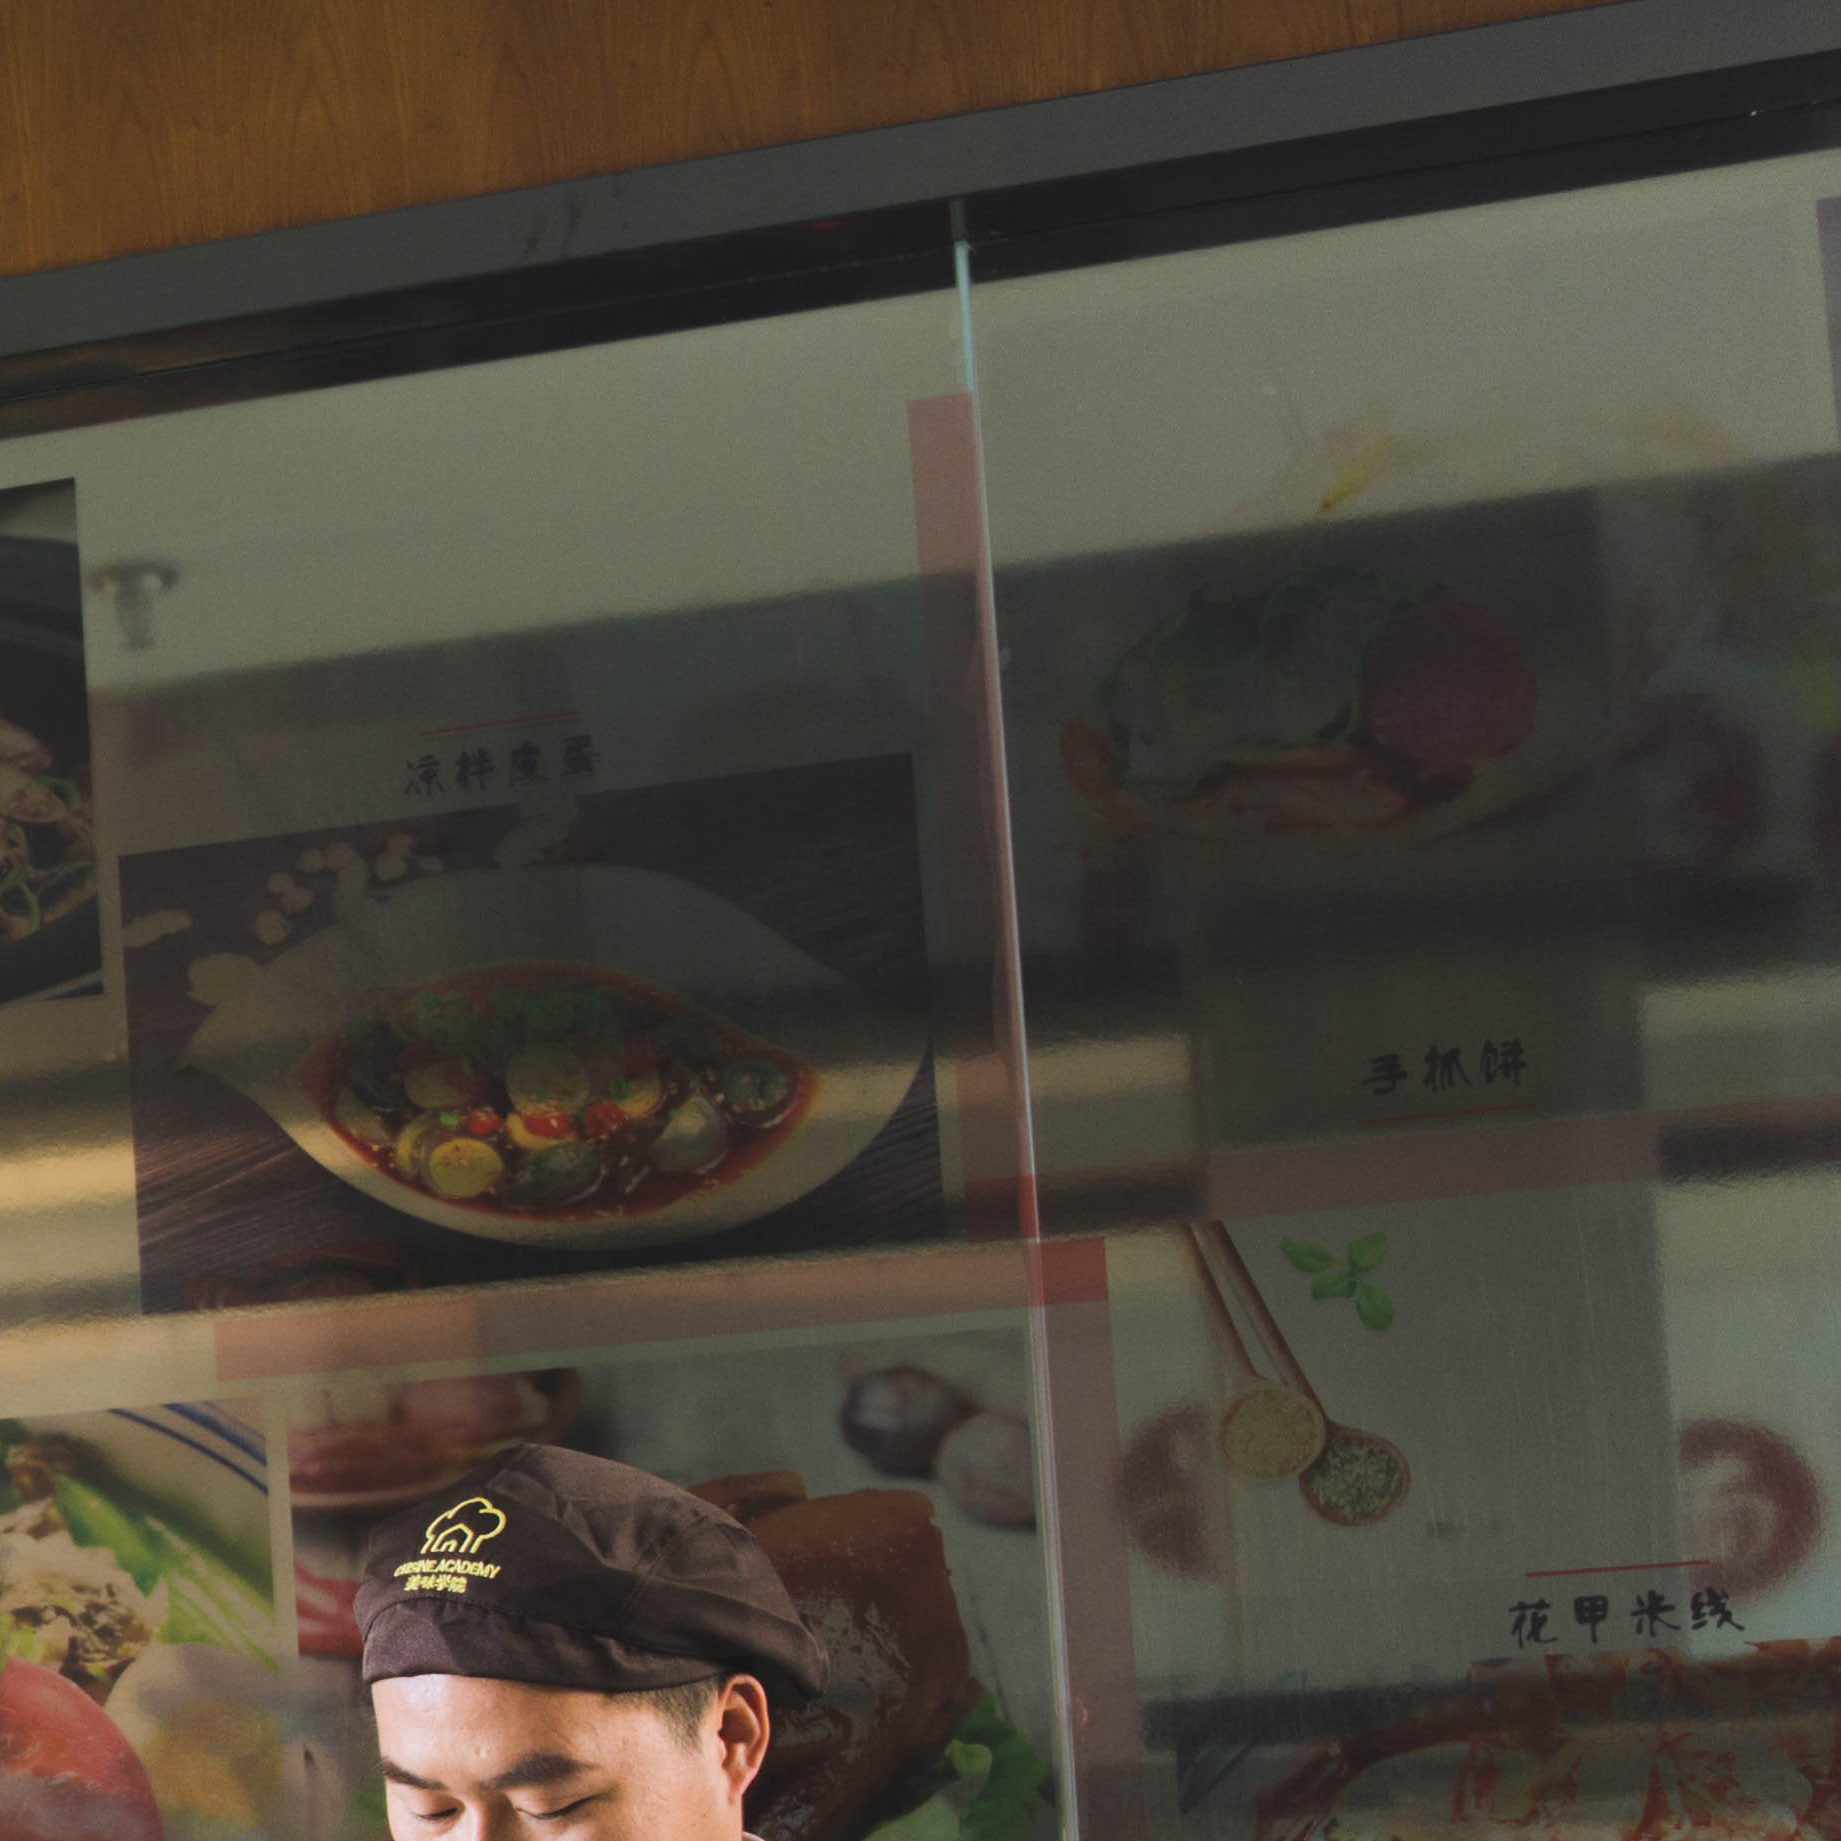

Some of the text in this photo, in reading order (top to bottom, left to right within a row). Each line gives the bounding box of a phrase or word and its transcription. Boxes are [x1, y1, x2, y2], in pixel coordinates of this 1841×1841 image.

[1361, 1036, 1529, 1096] 手抓饼
[393, 1558, 501, 1579] CUISINE ACADEMY
[403, 1573, 468, 1594] 美味学院
[1507, 1585, 1746, 1650] 花甲米线
